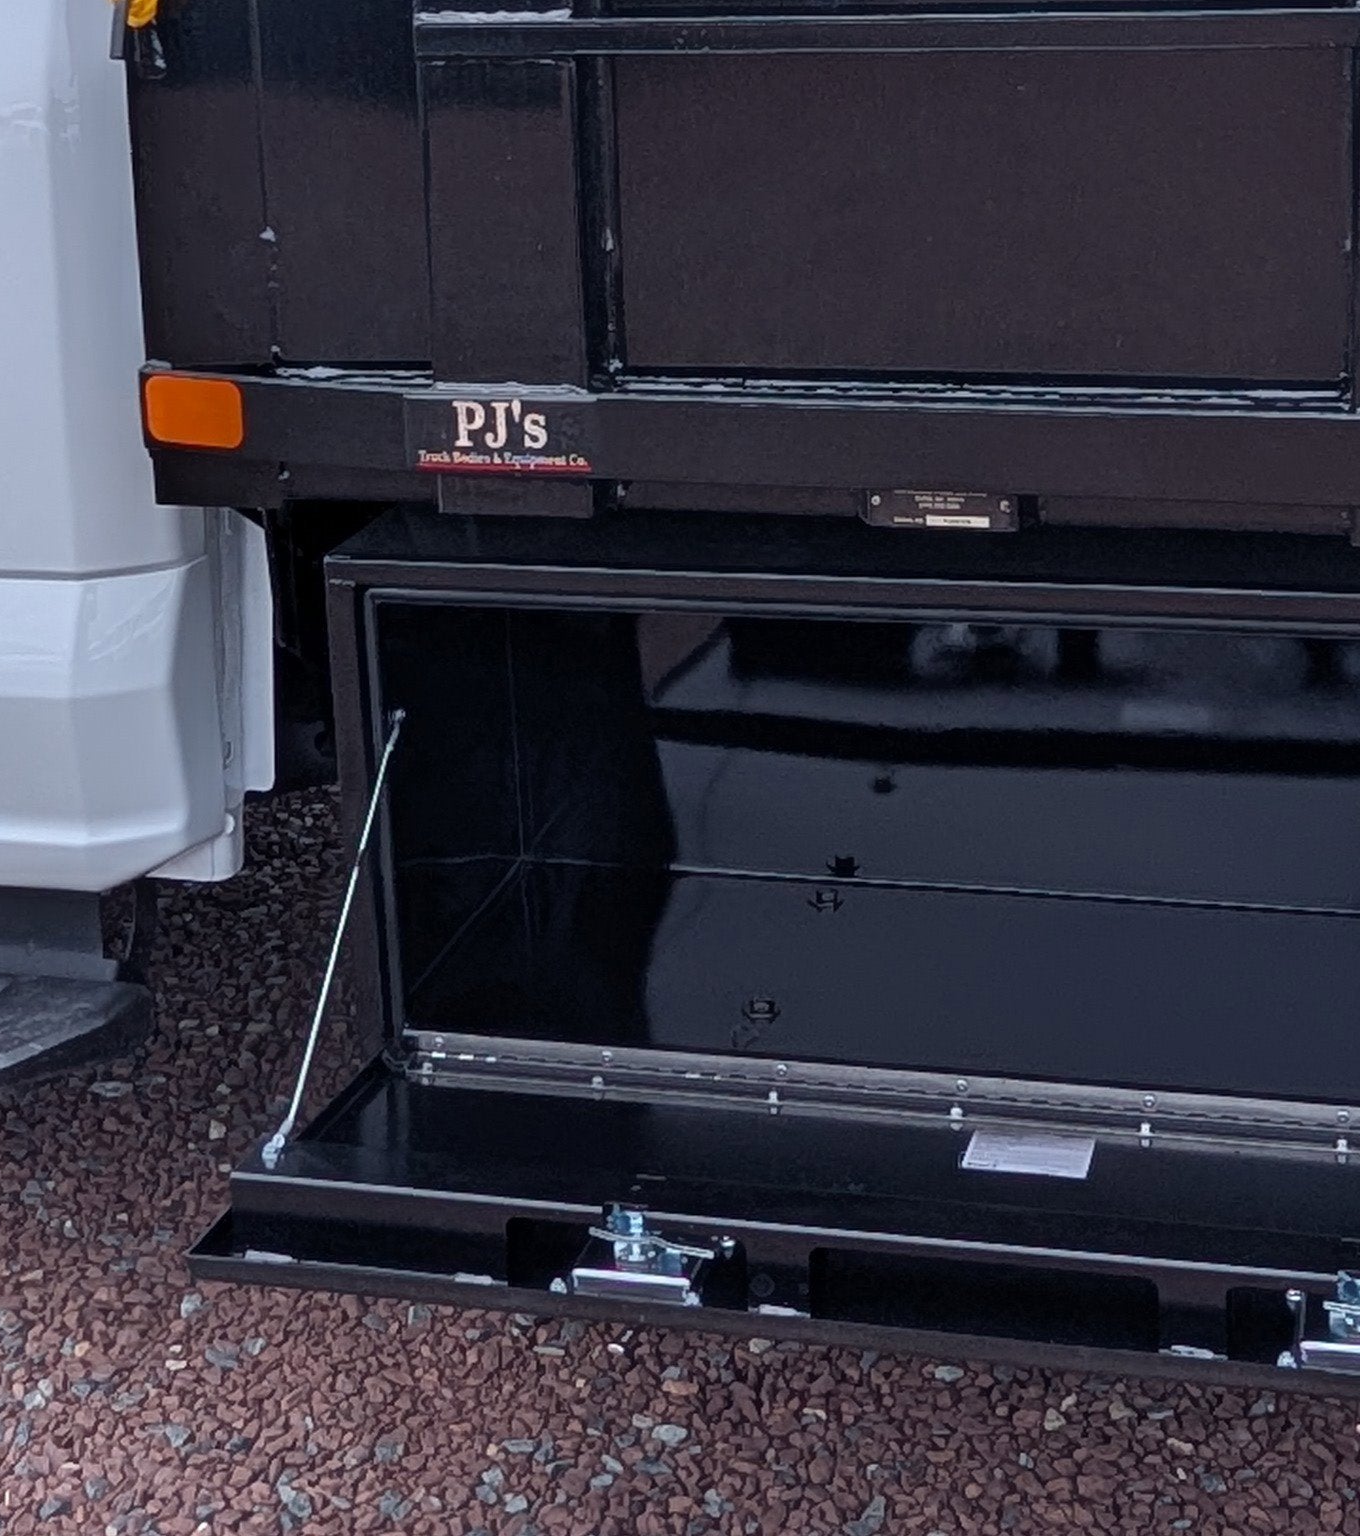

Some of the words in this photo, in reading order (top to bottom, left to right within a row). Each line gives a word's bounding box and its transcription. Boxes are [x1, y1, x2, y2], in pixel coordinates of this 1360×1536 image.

[452, 398, 548, 449] PJ's
[418, 449, 451, 464] Truck
[452, 451, 491, 464] Bodies
[492, 451, 502, 464] &
[503, 451, 566, 470] Equipment
[569, 452, 588, 466] Co.
